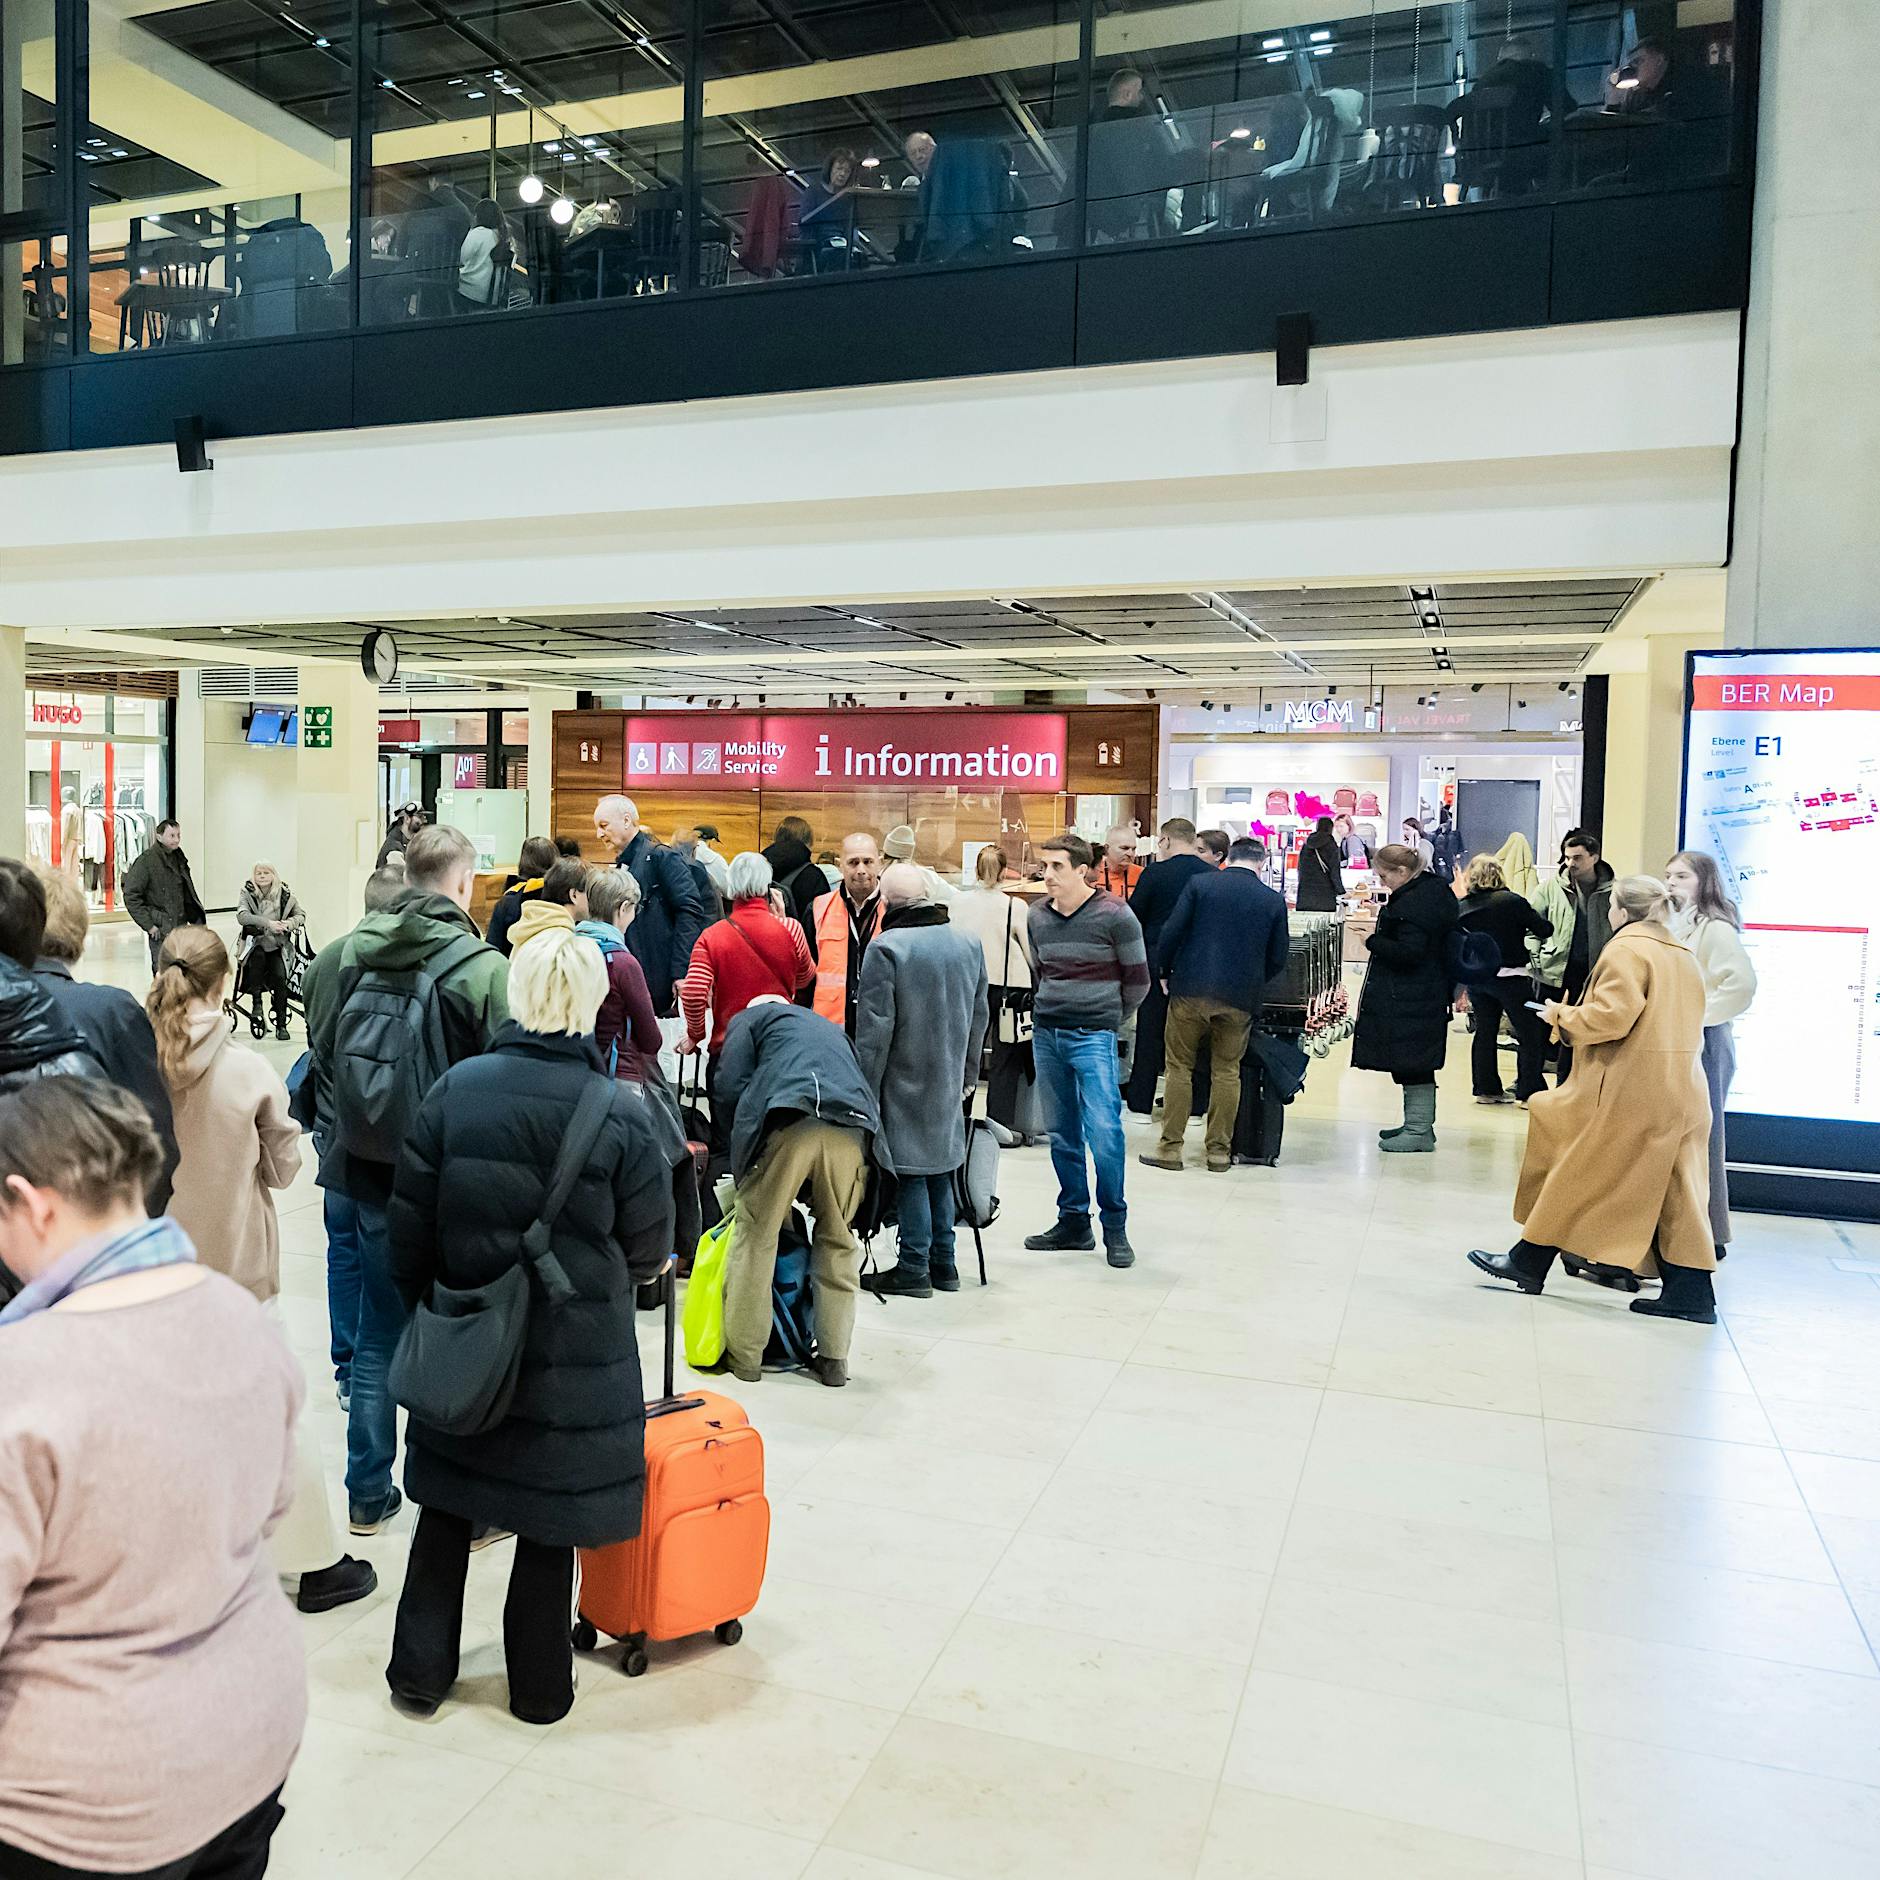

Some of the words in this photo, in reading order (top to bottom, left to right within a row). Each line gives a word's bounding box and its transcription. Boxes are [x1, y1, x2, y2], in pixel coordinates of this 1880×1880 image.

[1721, 683, 1770, 703] BER
[1779, 683, 1834, 707] Map
[33, 704, 82, 724] HUGO
[1284, 700, 1354, 724] MCM
[724, 742, 787, 760] Mobility
[1711, 737, 1746, 746] Ebene
[1755, 736, 1782, 756] E1
[1711, 749, 1735, 757] Level
[724, 760, 778, 775] Service
[844, 744, 1057, 777] Information
